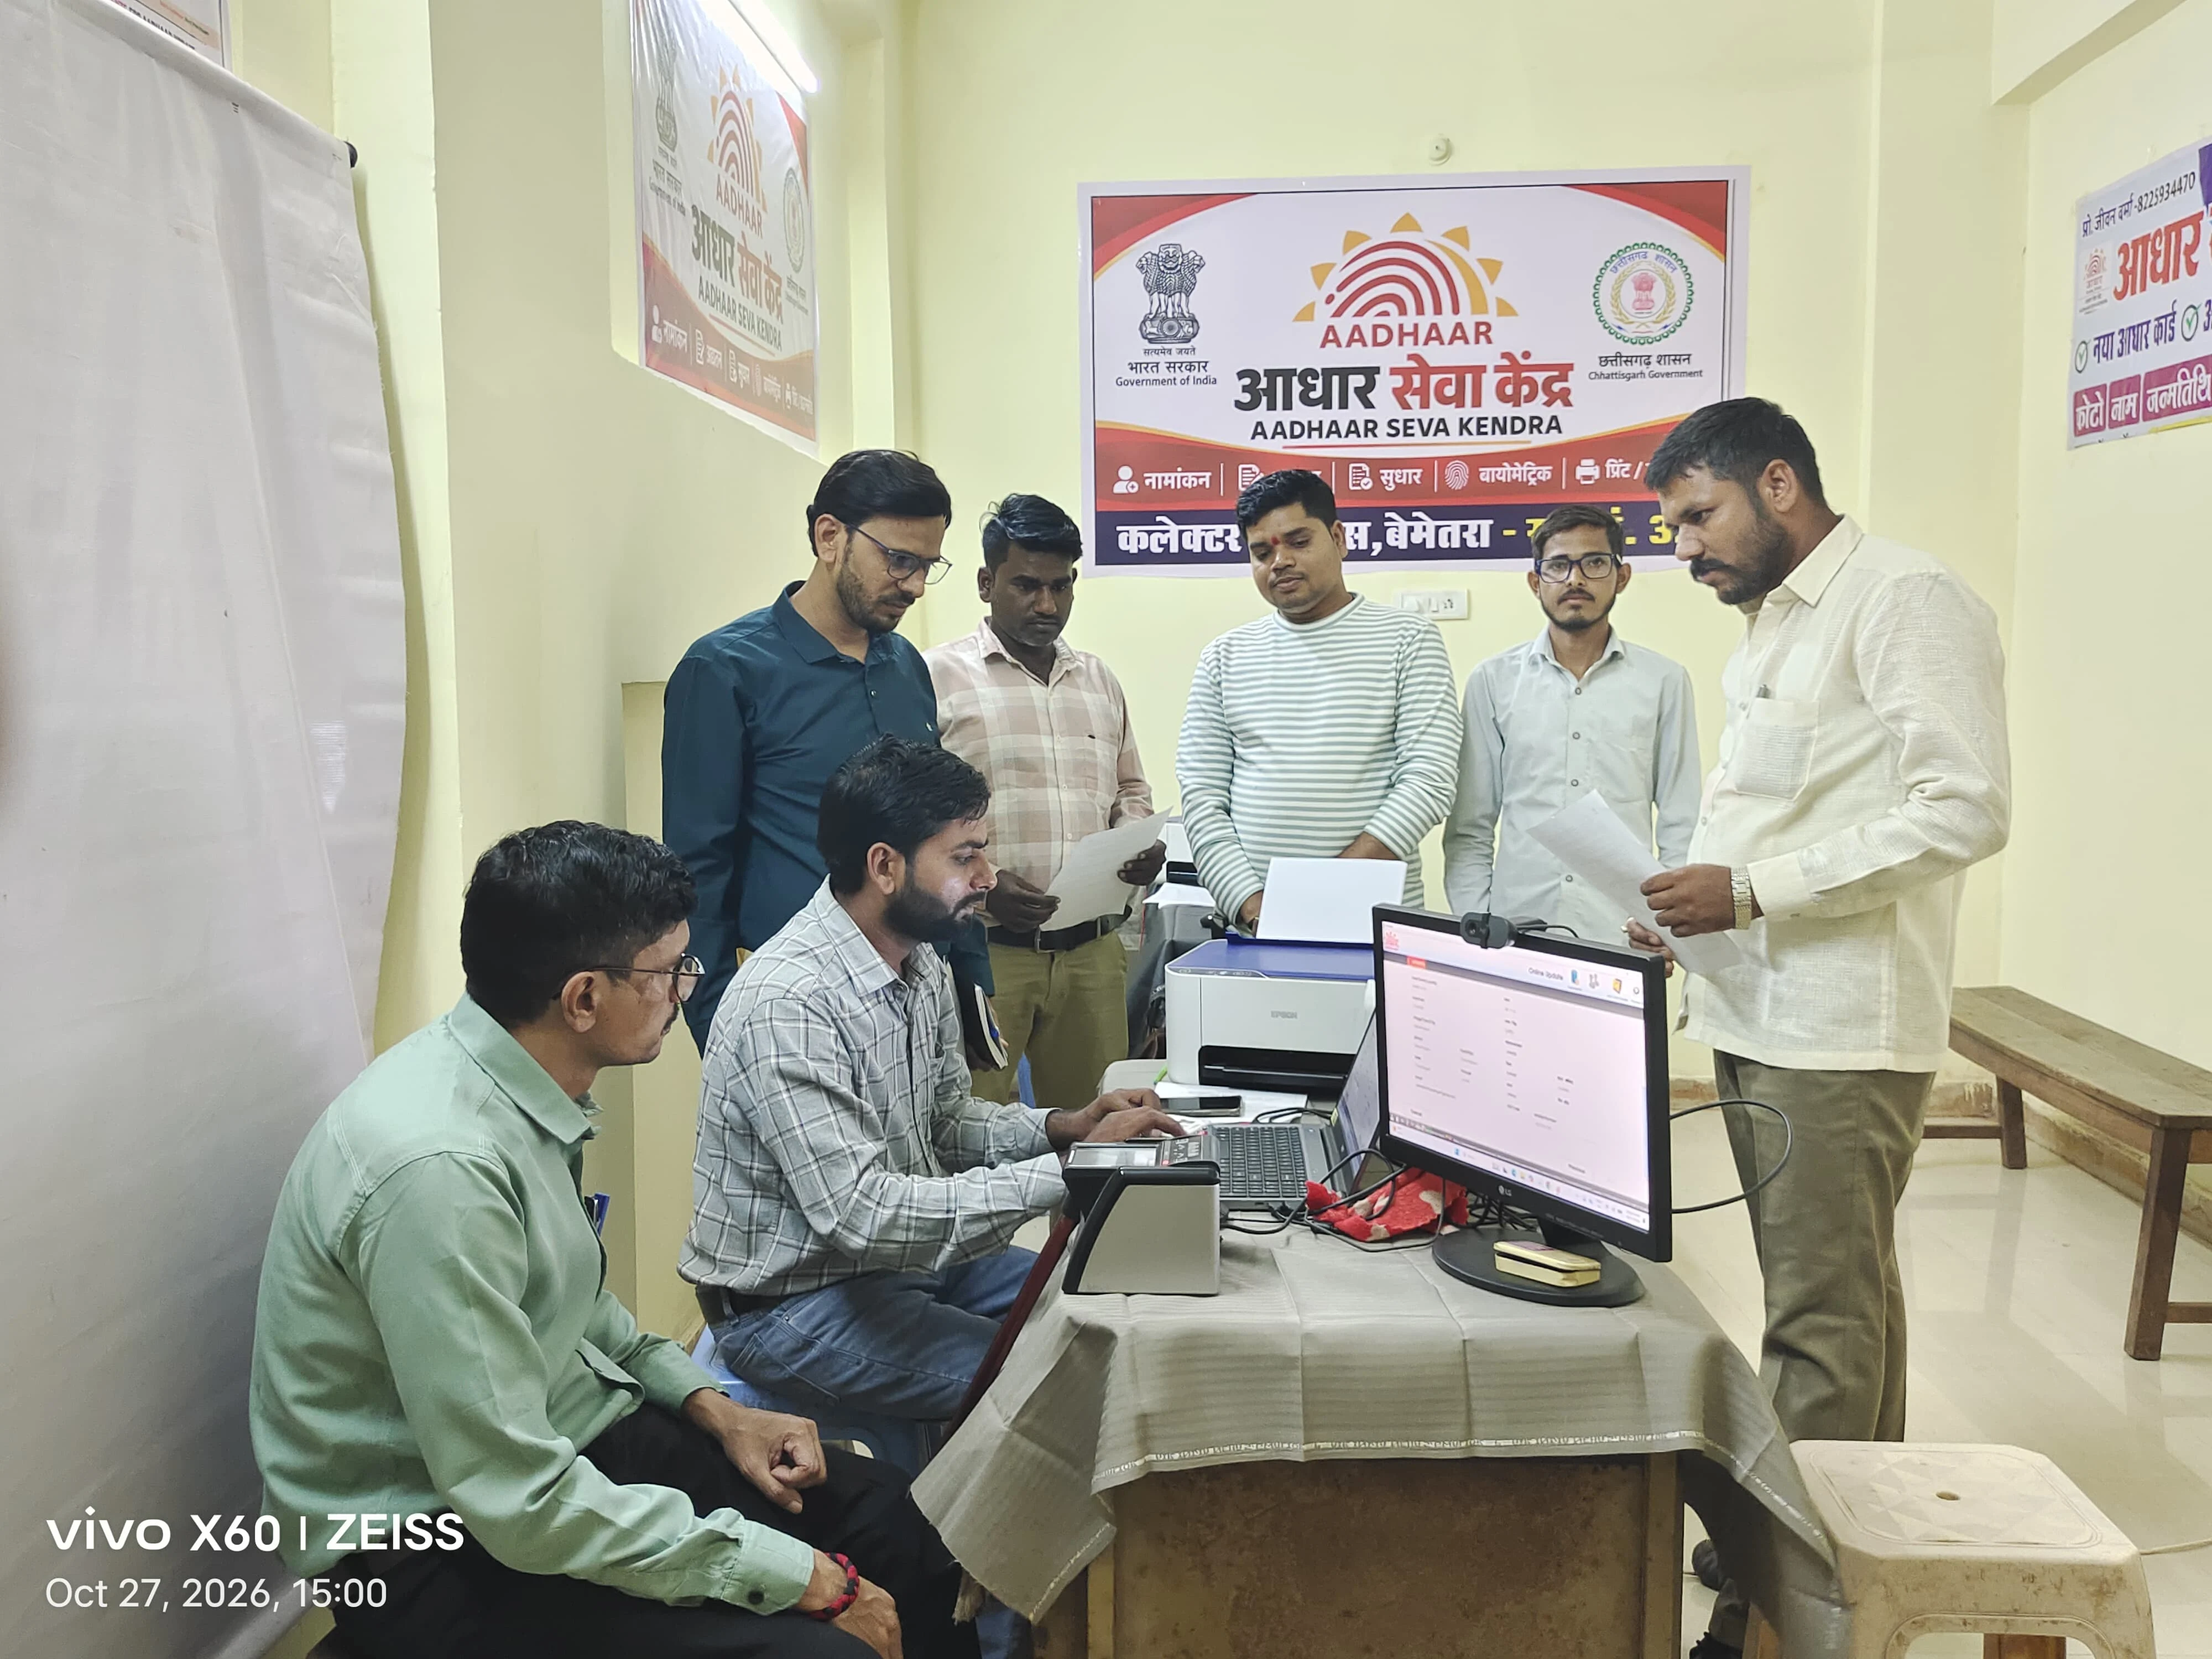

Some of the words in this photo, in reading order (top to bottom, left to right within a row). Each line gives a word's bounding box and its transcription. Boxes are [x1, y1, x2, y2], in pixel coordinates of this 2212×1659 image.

[717, 173, 763, 239] AADHAAR
[2094, 207, 2116, 231] जीवन
[2119, 192, 2134, 221] वर्मा
[691, 204, 735, 288] आधार
[737, 229, 762, 309] सेवा
[1655, 253, 1677, 273] शासन
[2113, 210, 2204, 301] आधार
[698, 275, 737, 326] AADHAAR
[738, 302, 756, 336] SEVA
[757, 315, 782, 352] KENDRA
[1319, 321, 1493, 348] AADHAAR
[2093, 331, 2115, 364] नया
[2117, 320, 2151, 358] आधार
[2153, 299, 2177, 346] कार्ड
[1143, 346, 1172, 356] सत्यमेव
[1176, 345, 1196, 356] जयते
[1598, 352, 1652, 368] छत्तीसगढ़
[1656, 353, 1692, 366] शासन
[1128, 361, 1160, 374] भारत
[1165, 360, 1209, 373] सरकार
[1589, 370, 1645, 382] Chhattisgarh
[1648, 369, 1703, 379] Government
[1116, 377, 1177, 387] Government
[1180, 375, 1190, 385] of
[1193, 375, 1217, 385] India
[1234, 366, 1380, 411] आधार
[1389, 353, 1486, 411] सेवा
[1495, 351, 1574, 408] केंद्र
[2146, 363, 2211, 413] जन्मतिथि
[2111, 393, 2138, 422] नाम
[1250, 419, 1378, 440] AADHAAR
[1386, 416, 1451, 437] SEVA
[1459, 414, 1563, 436] KENDRA
[1144, 467, 1212, 490] नामांकन
[1379, 465, 1423, 489] सुधार
[1479, 460, 1552, 487] बायोमेट्रिक
[1115, 515, 1243, 554] कलेक्टर
[1271, 1010, 1297, 1019] EPSON
